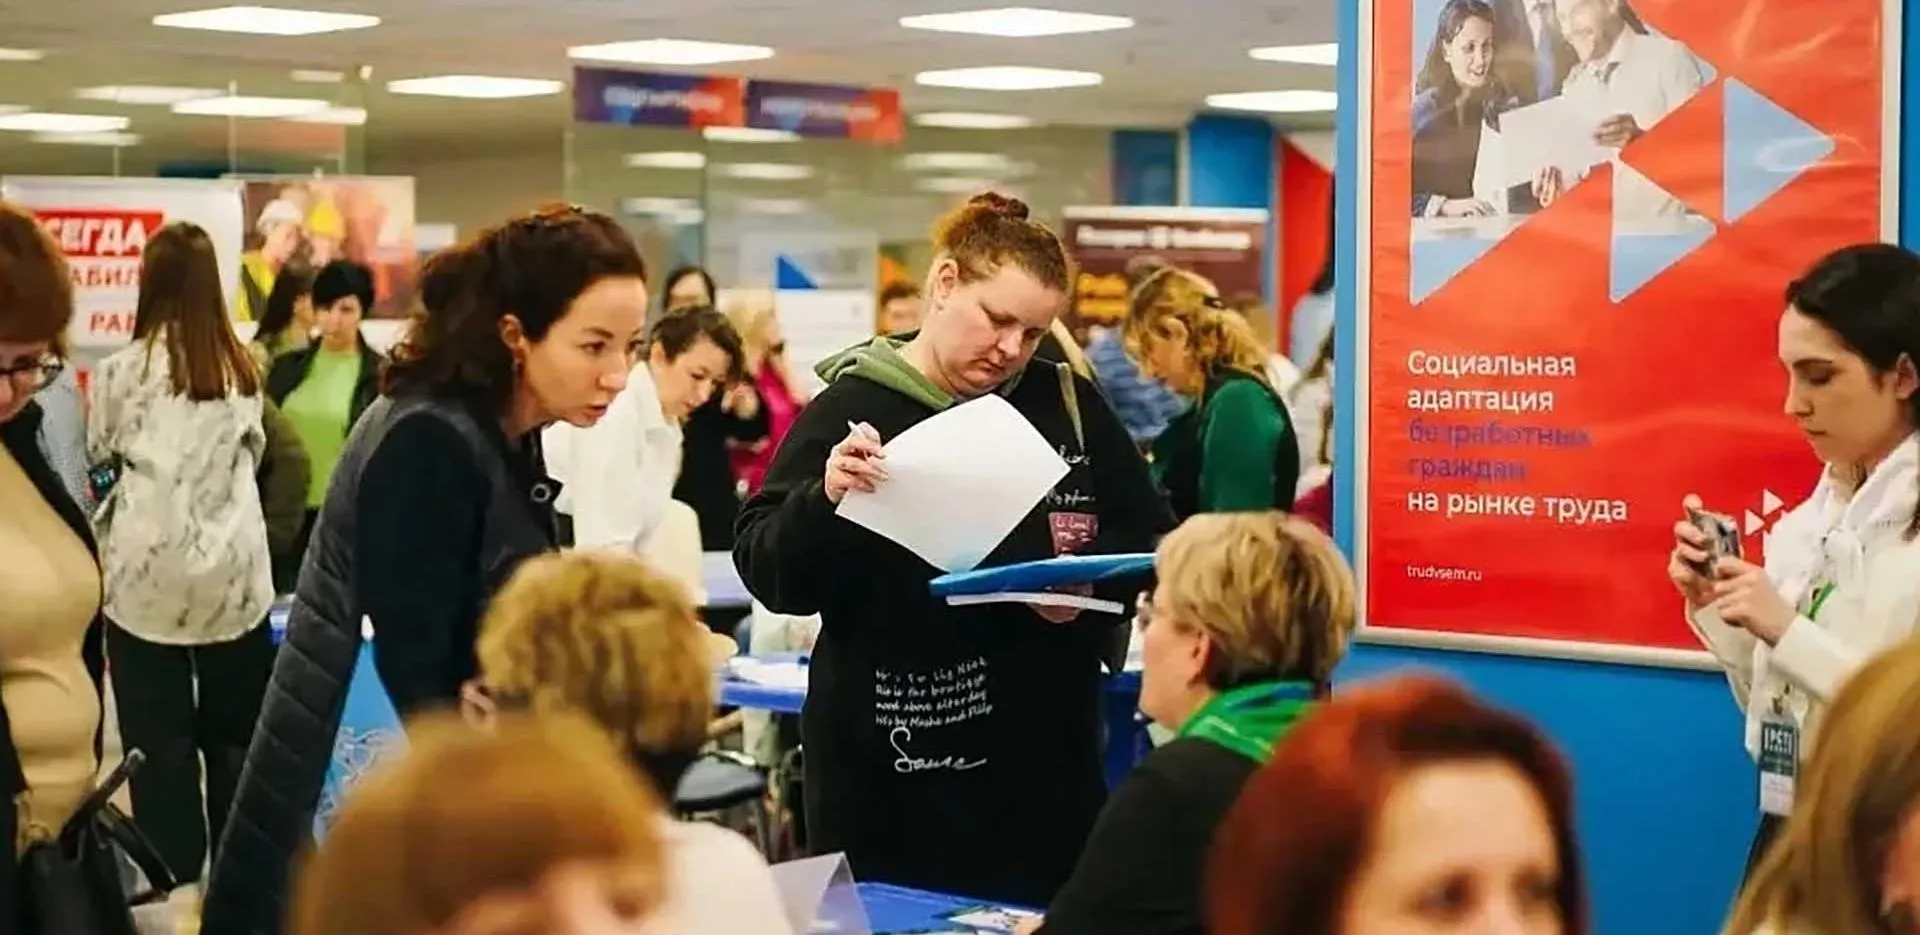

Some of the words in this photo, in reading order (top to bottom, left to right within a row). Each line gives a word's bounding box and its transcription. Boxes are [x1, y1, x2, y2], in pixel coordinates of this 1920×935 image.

[41, 216, 147, 255] СЕГДА
[1407, 350, 1576, 377] Социальная
[1407, 388, 1553, 414] адаптация
[1407, 491, 1439, 512] на
[1447, 492, 1535, 518] рынке
[1545, 496, 1628, 523] труда
[1407, 565, 1482, 581] trudvsem.ru
